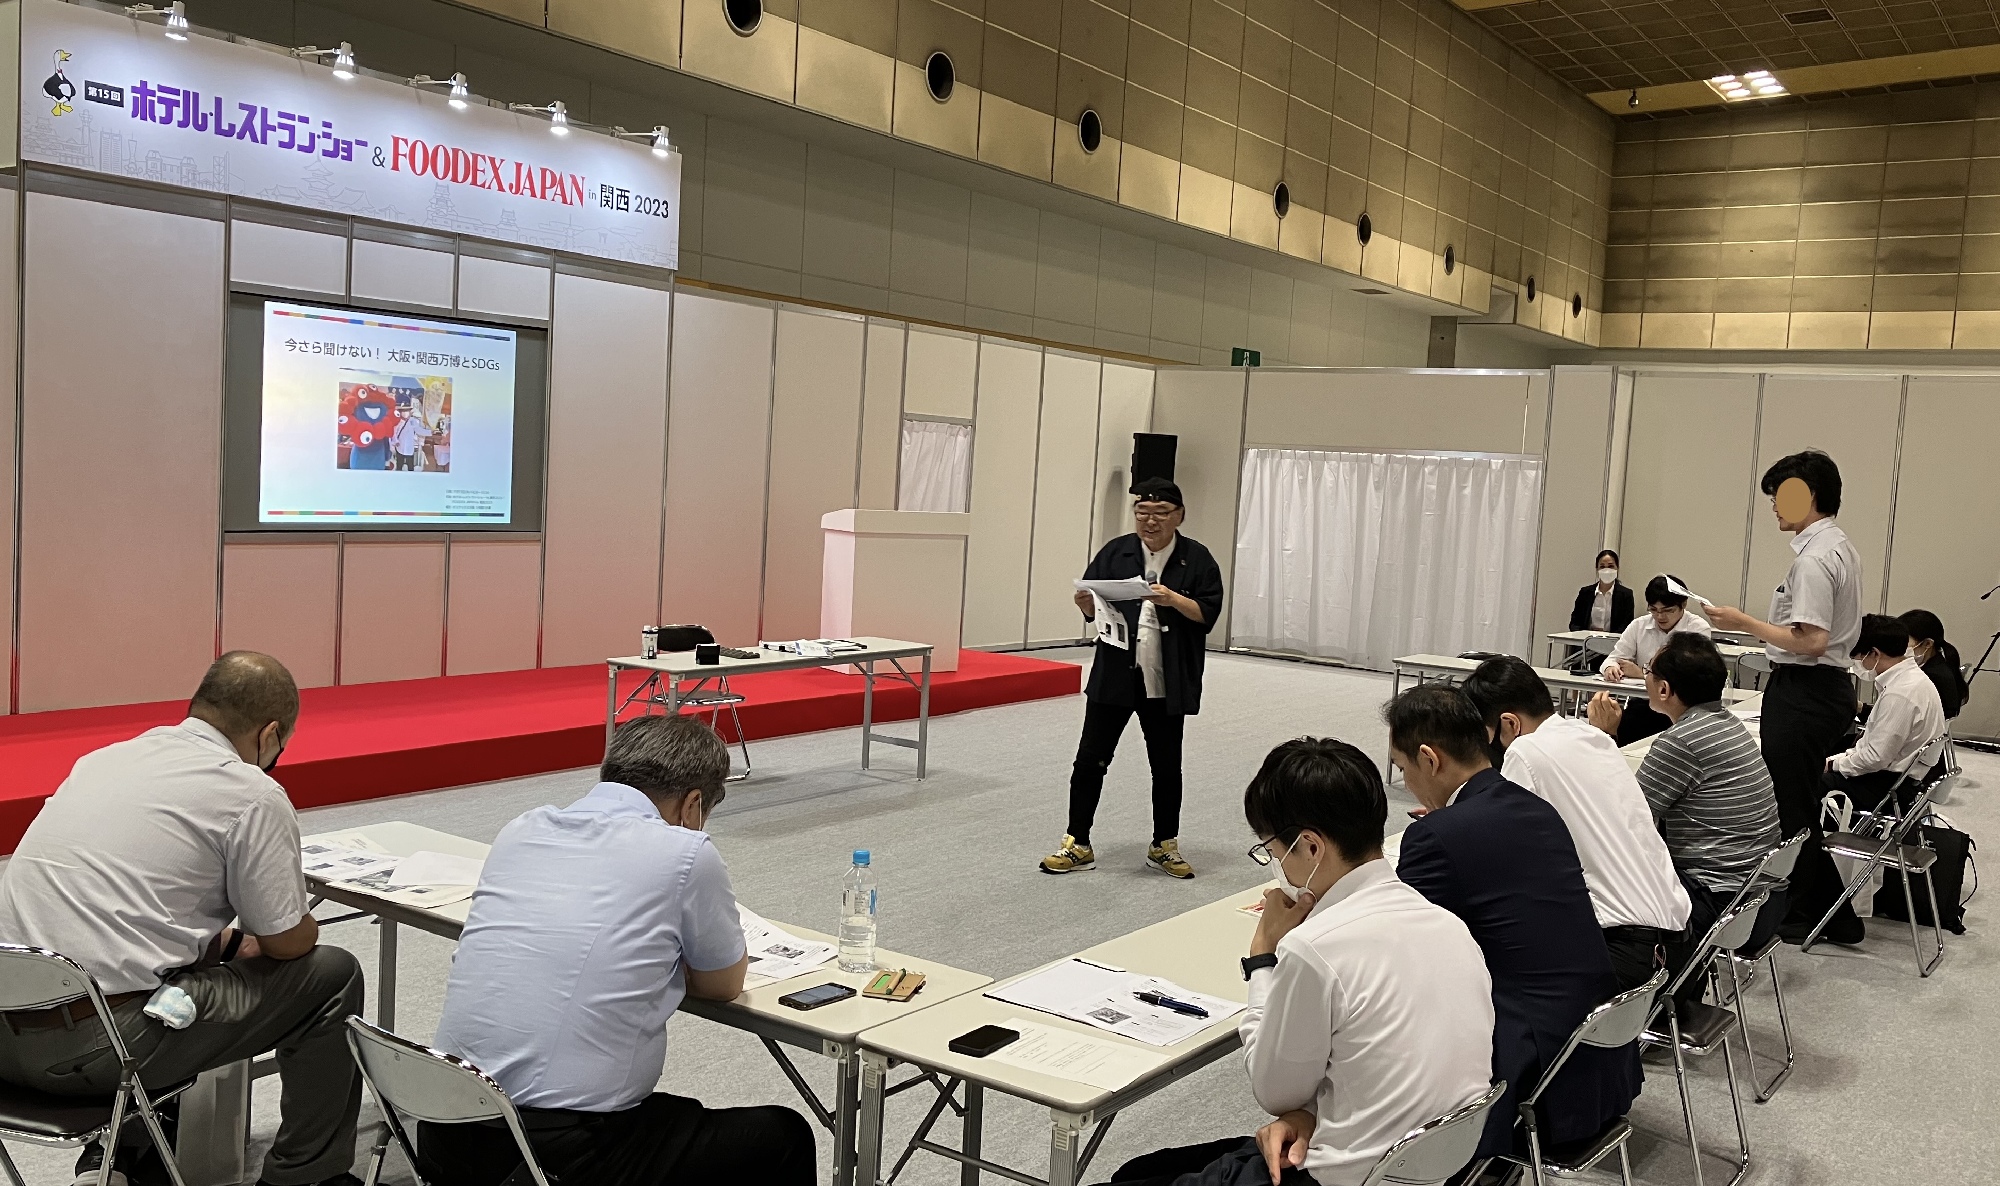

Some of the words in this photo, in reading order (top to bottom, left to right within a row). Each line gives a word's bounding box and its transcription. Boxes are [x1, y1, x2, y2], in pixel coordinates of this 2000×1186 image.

[87, 85, 121, 103] 第15回
[371, 145, 386, 168] &
[390, 134, 506, 193] FOODEX
[508, 160, 586, 208] JAPAN
[588, 188, 597, 201] in
[600, 182, 631, 213] 関西
[634, 194, 670, 219] 2023
